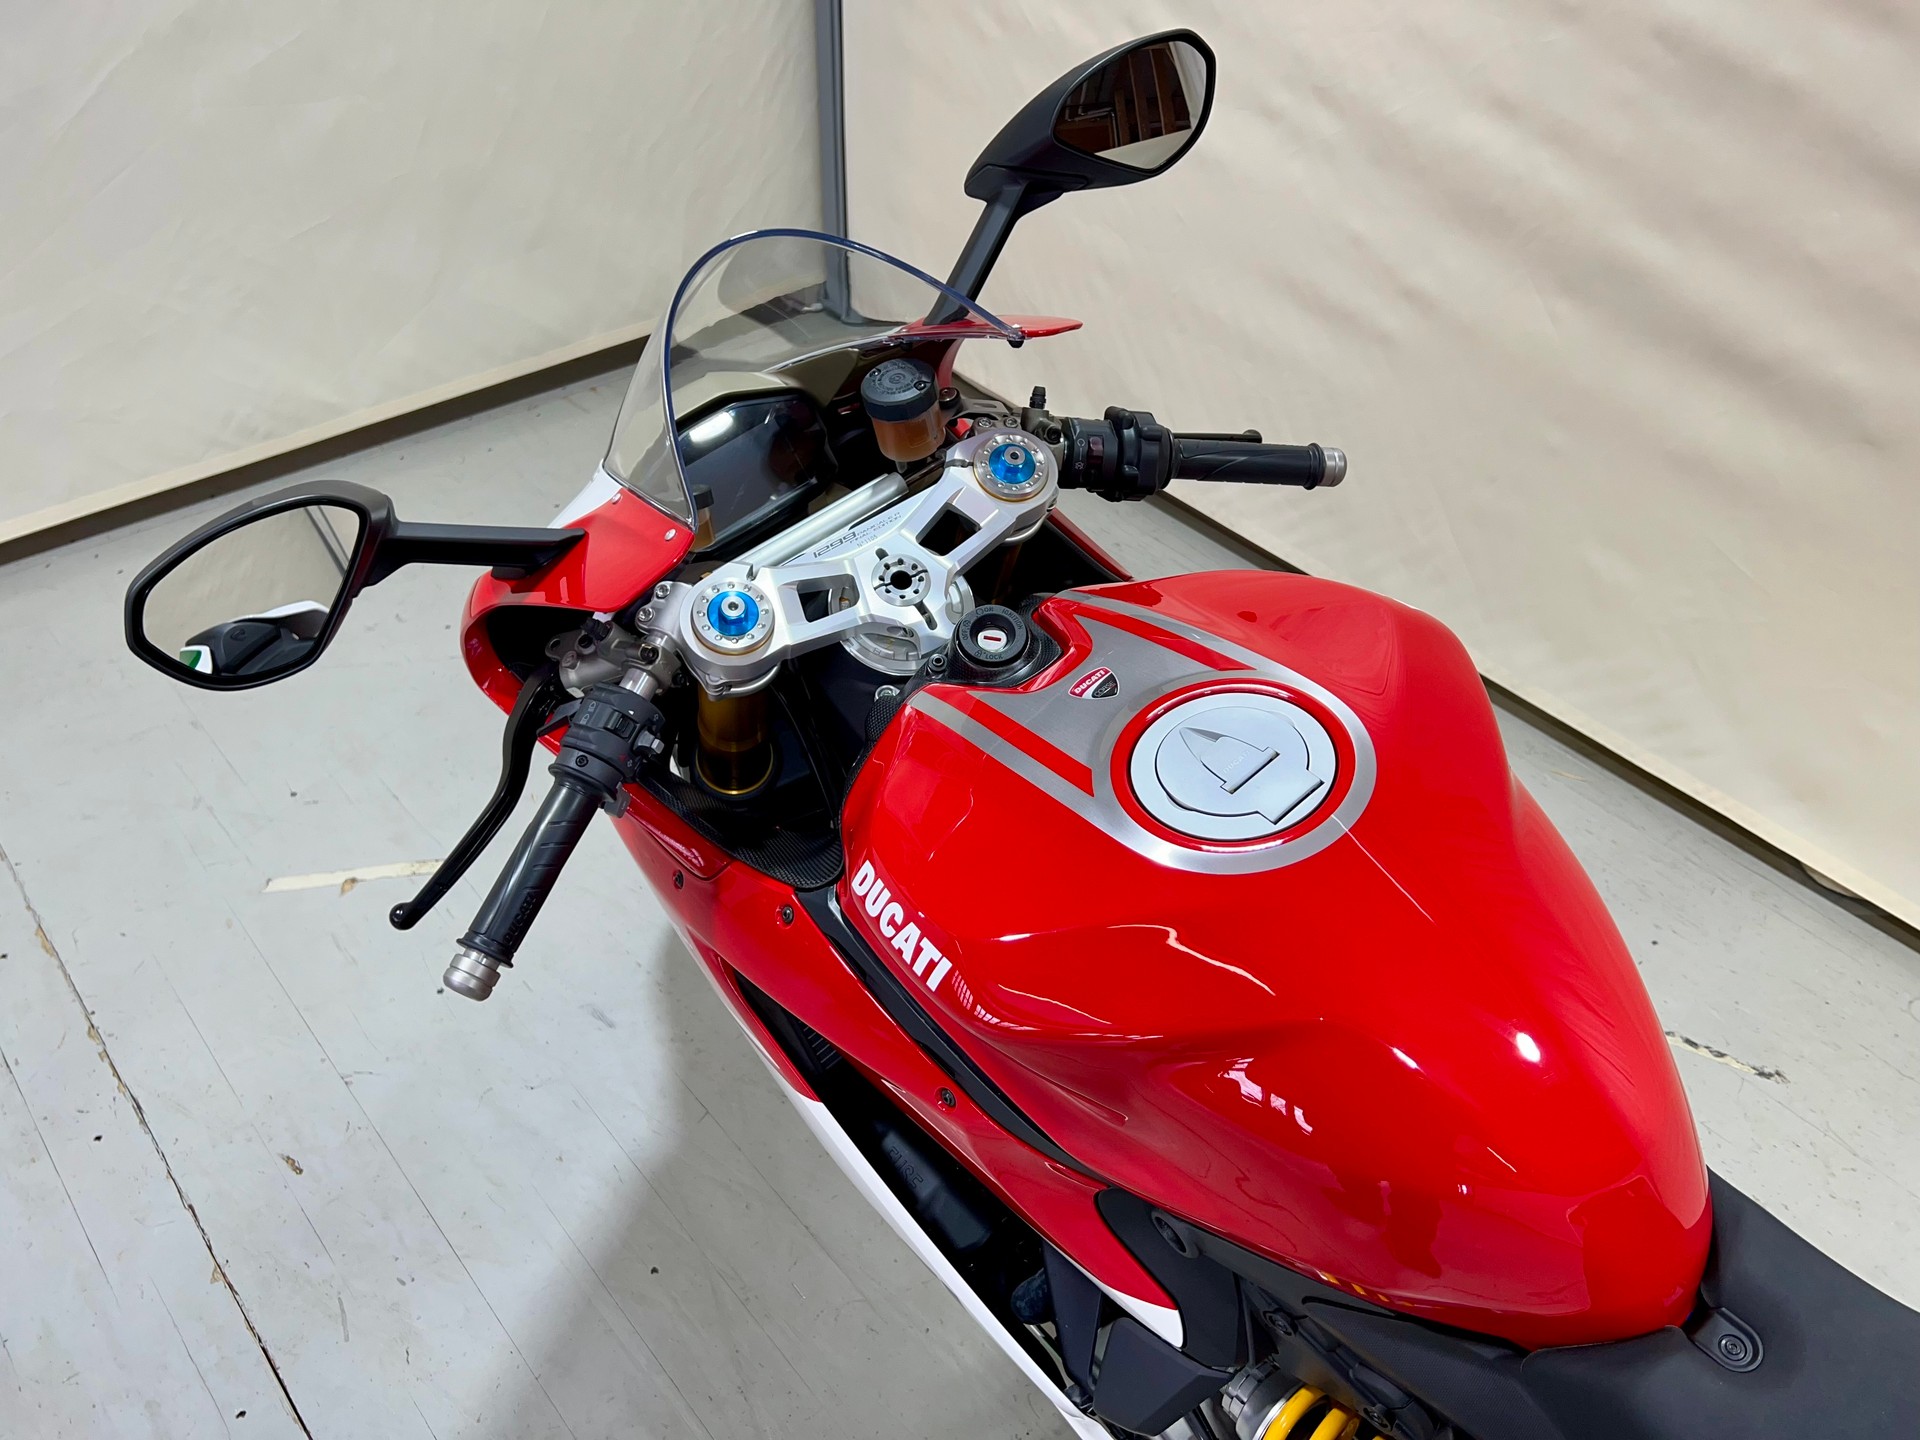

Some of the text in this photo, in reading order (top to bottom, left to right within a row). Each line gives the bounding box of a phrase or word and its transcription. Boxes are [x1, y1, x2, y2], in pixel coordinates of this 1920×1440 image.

[813, 531, 857, 558] 1299
[1002, 607, 1024, 630] IGNITION
[985, 652, 1004, 660] LOCK
[1074, 669, 1106, 694] DUCATI
[1094, 679, 1117, 698] CORSE
[851, 859, 953, 992] DUCATI
